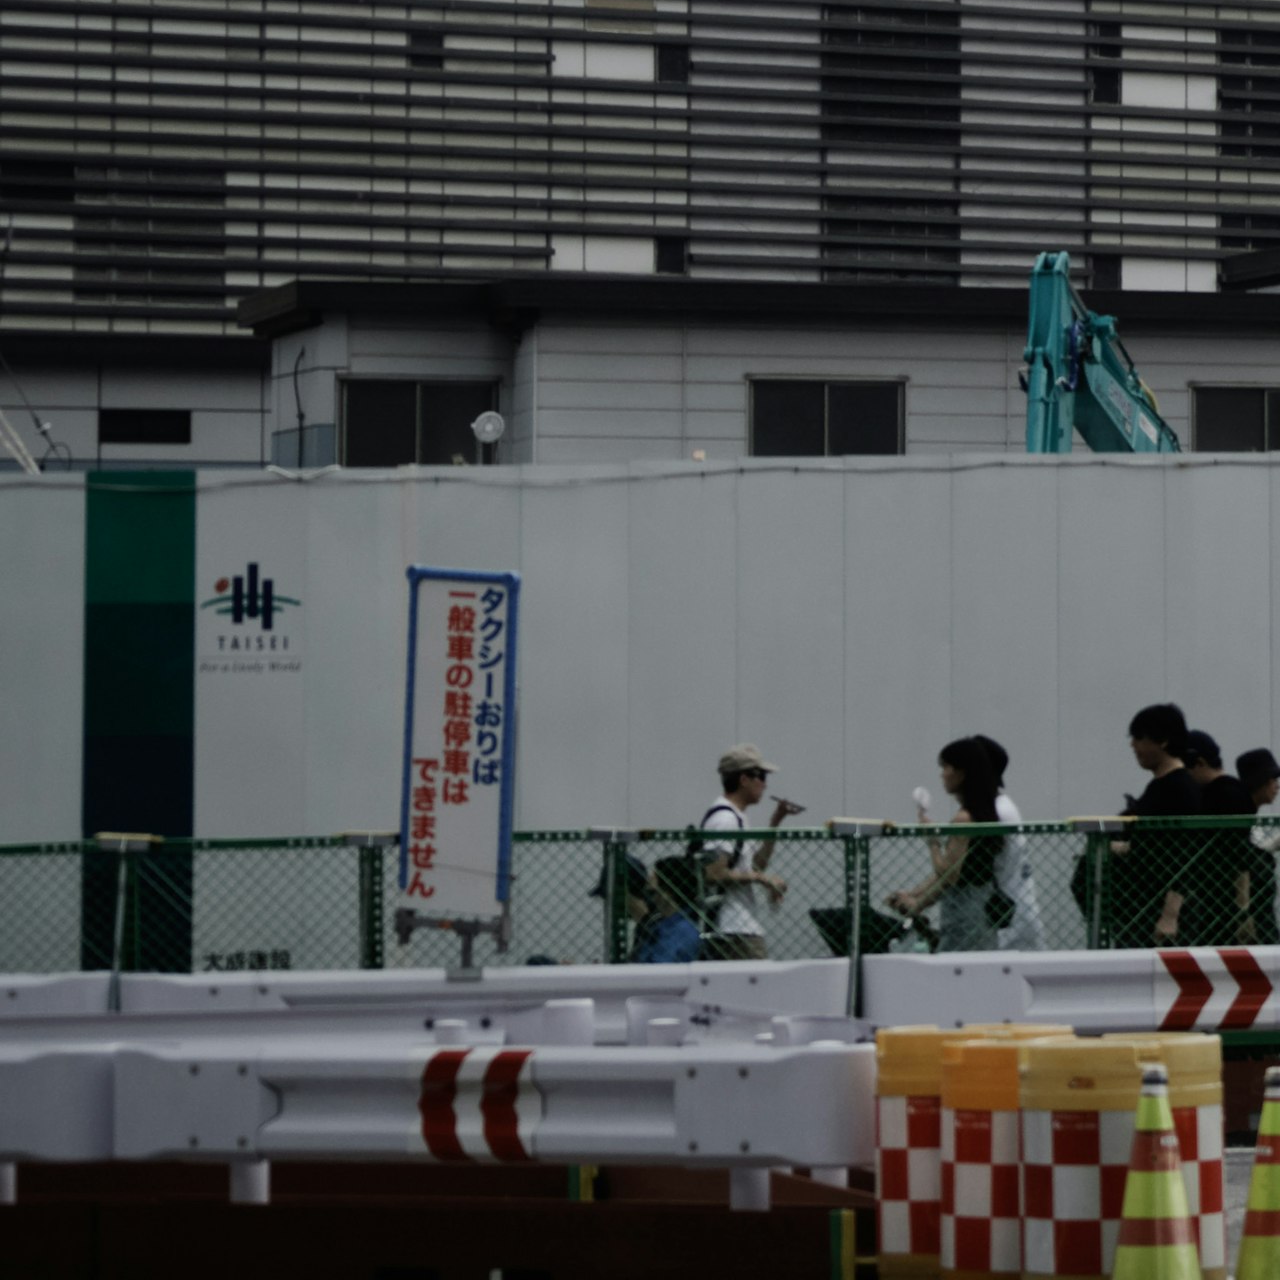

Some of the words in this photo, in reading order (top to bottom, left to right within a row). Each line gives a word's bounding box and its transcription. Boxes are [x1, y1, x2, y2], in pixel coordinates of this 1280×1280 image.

[217, 634, 290, 651] TAISEI
[442, 589, 477, 806] 一般車の駐停車は
[472, 587, 505, 786] タクシーおりば
[406, 756, 439, 900] できません
